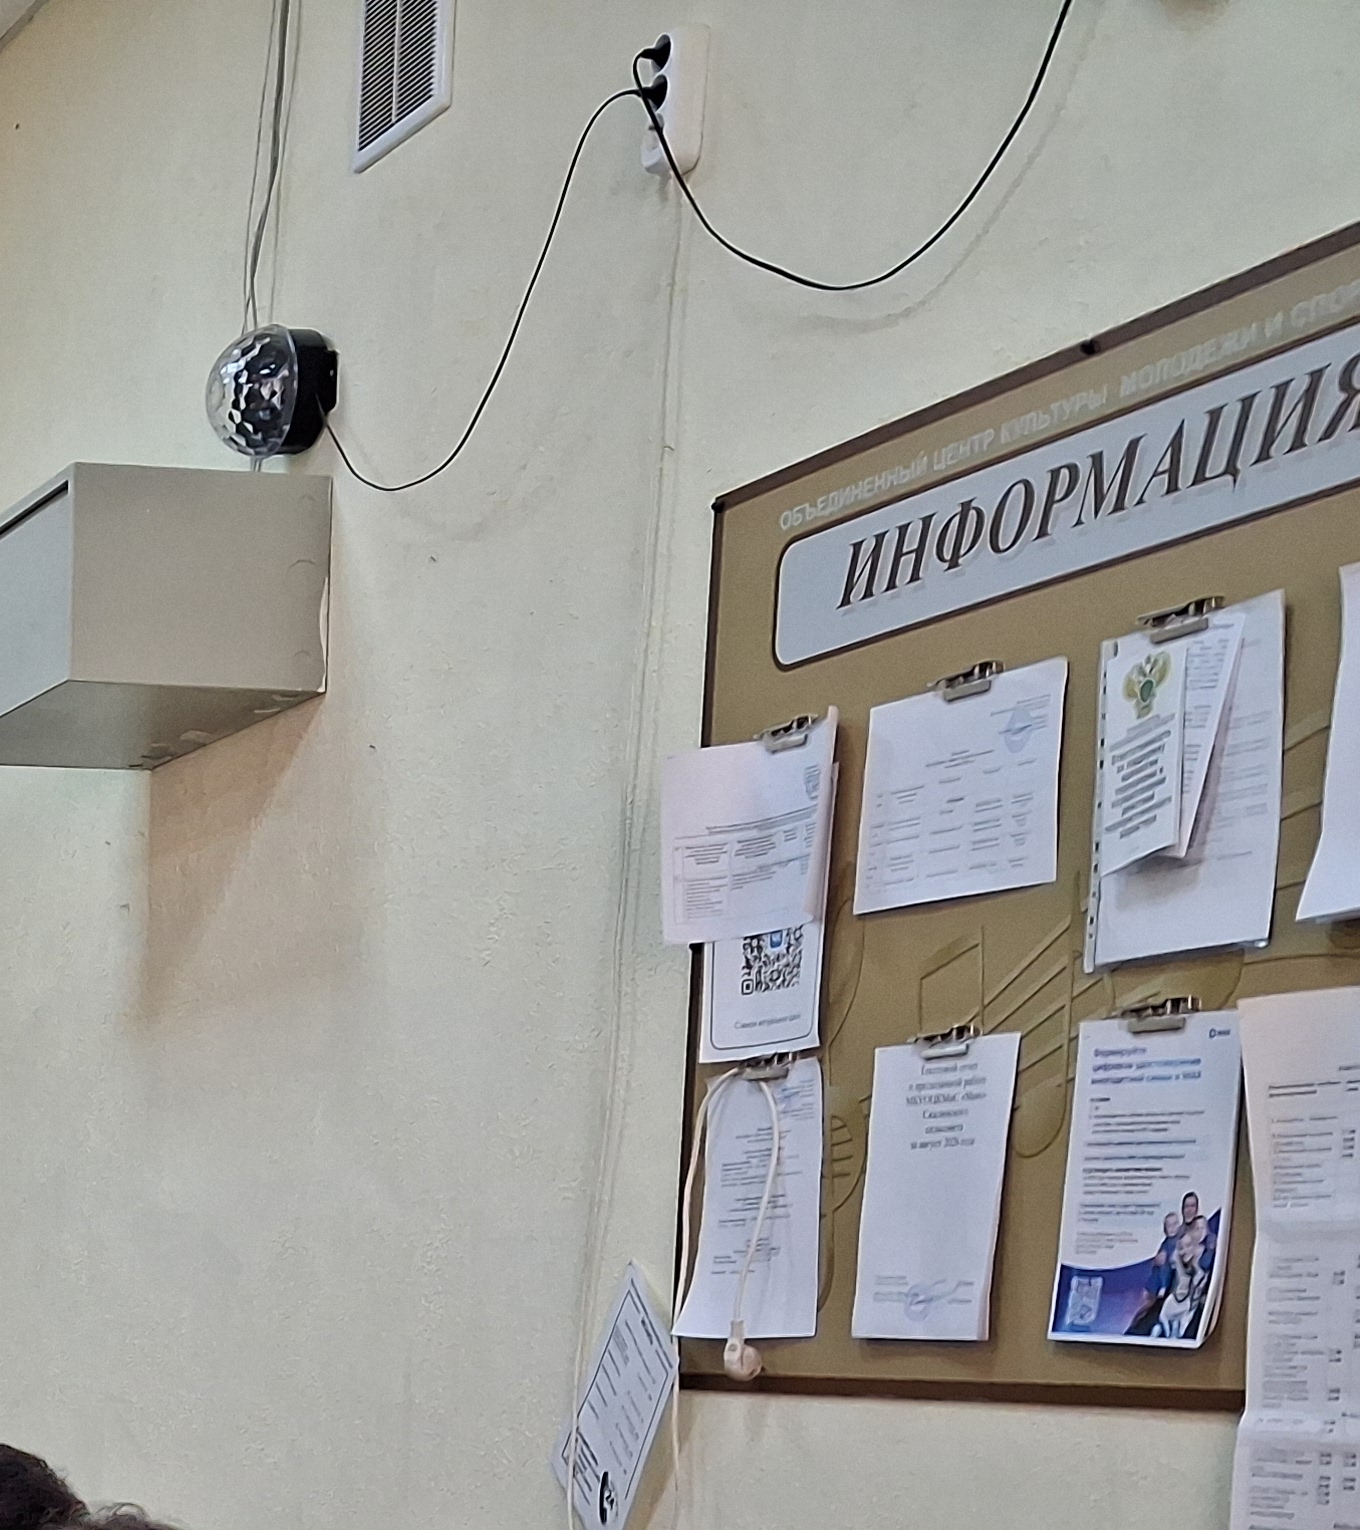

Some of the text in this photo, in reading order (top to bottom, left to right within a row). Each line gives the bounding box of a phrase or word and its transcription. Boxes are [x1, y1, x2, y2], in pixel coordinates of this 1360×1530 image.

[780, 451, 928, 530] ОБЪЕДИНЕННЫЙ
[933, 428, 995, 471] ЦЕНТР
[999, 384, 1108, 445] КУЛЬТУРЫ
[1290, 279, 1360, 327] СПО
